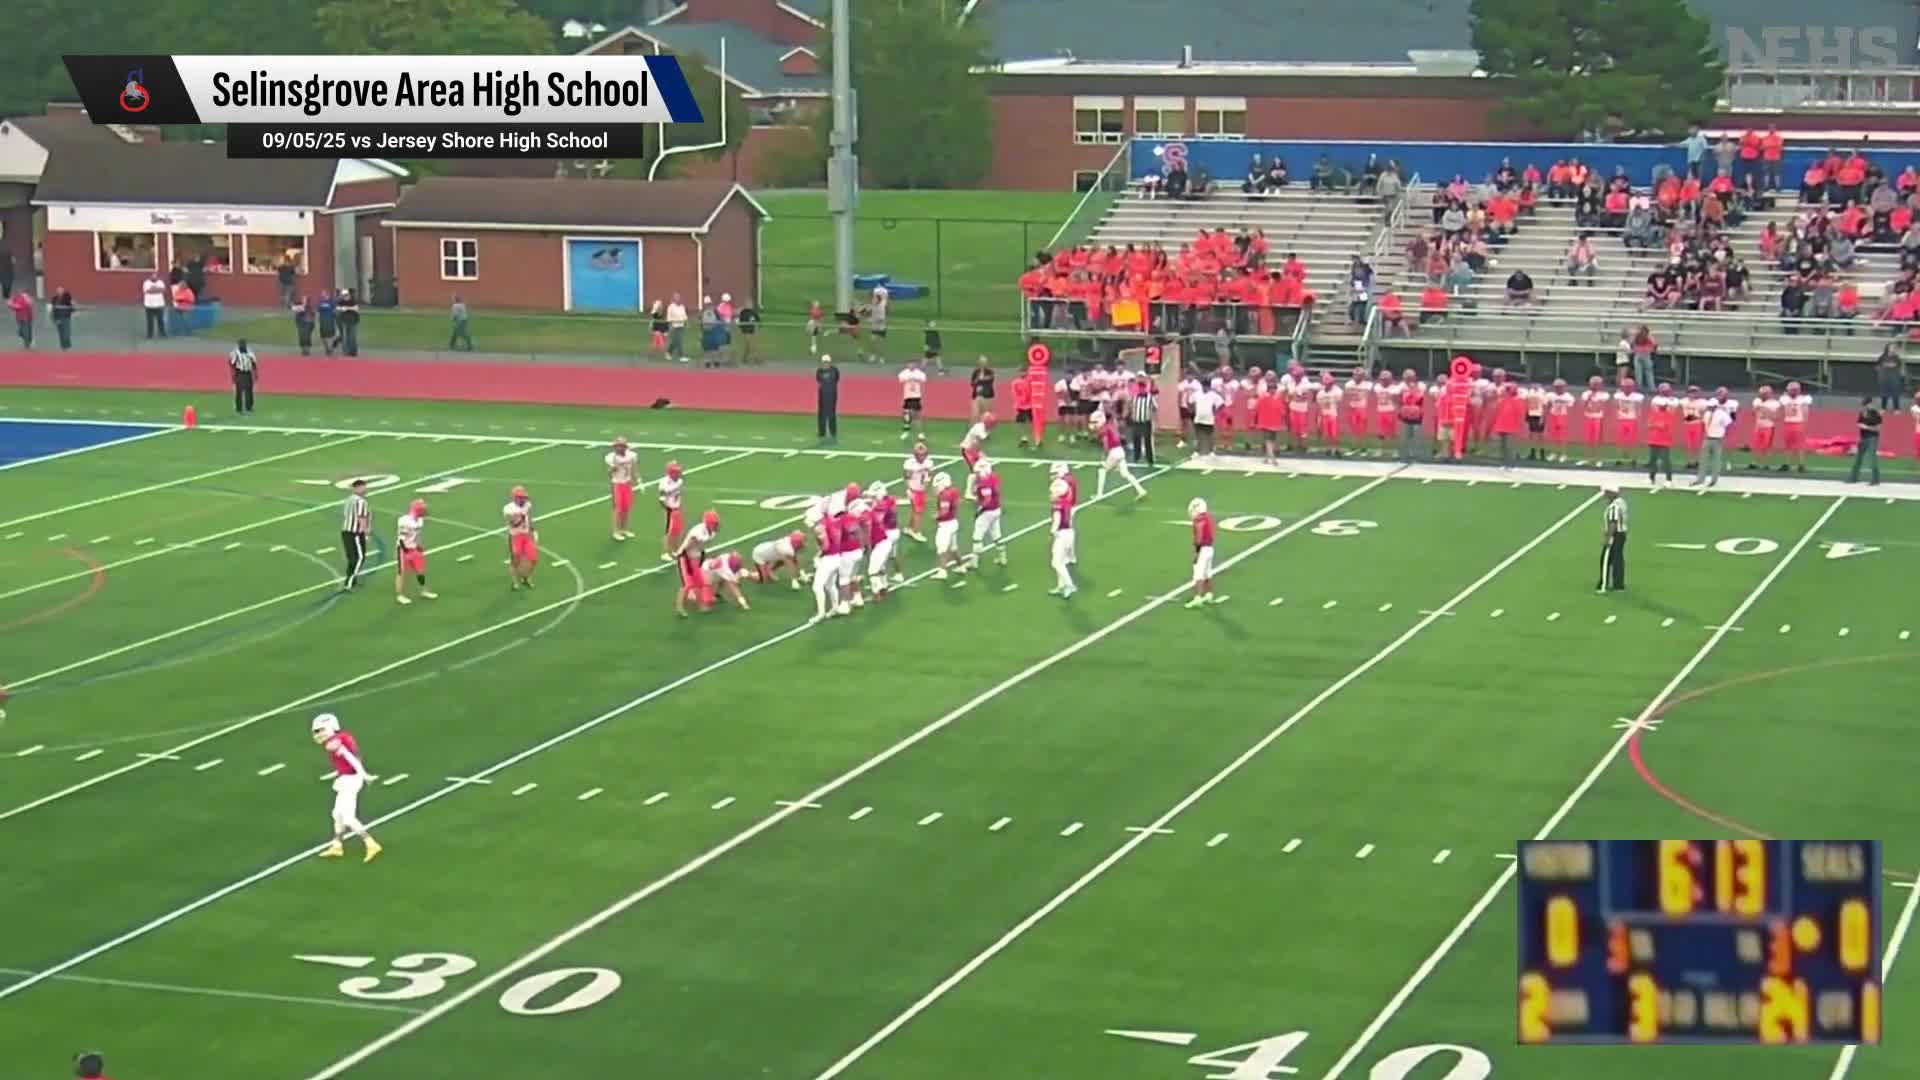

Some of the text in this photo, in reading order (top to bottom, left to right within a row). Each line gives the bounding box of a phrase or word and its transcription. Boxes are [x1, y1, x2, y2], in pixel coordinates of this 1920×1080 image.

[1545, 896, 1579, 966] 0
[1839, 899, 1870, 970] 0
[1518, 973, 1551, 1043] 2
[1628, 974, 1659, 1043] 3
